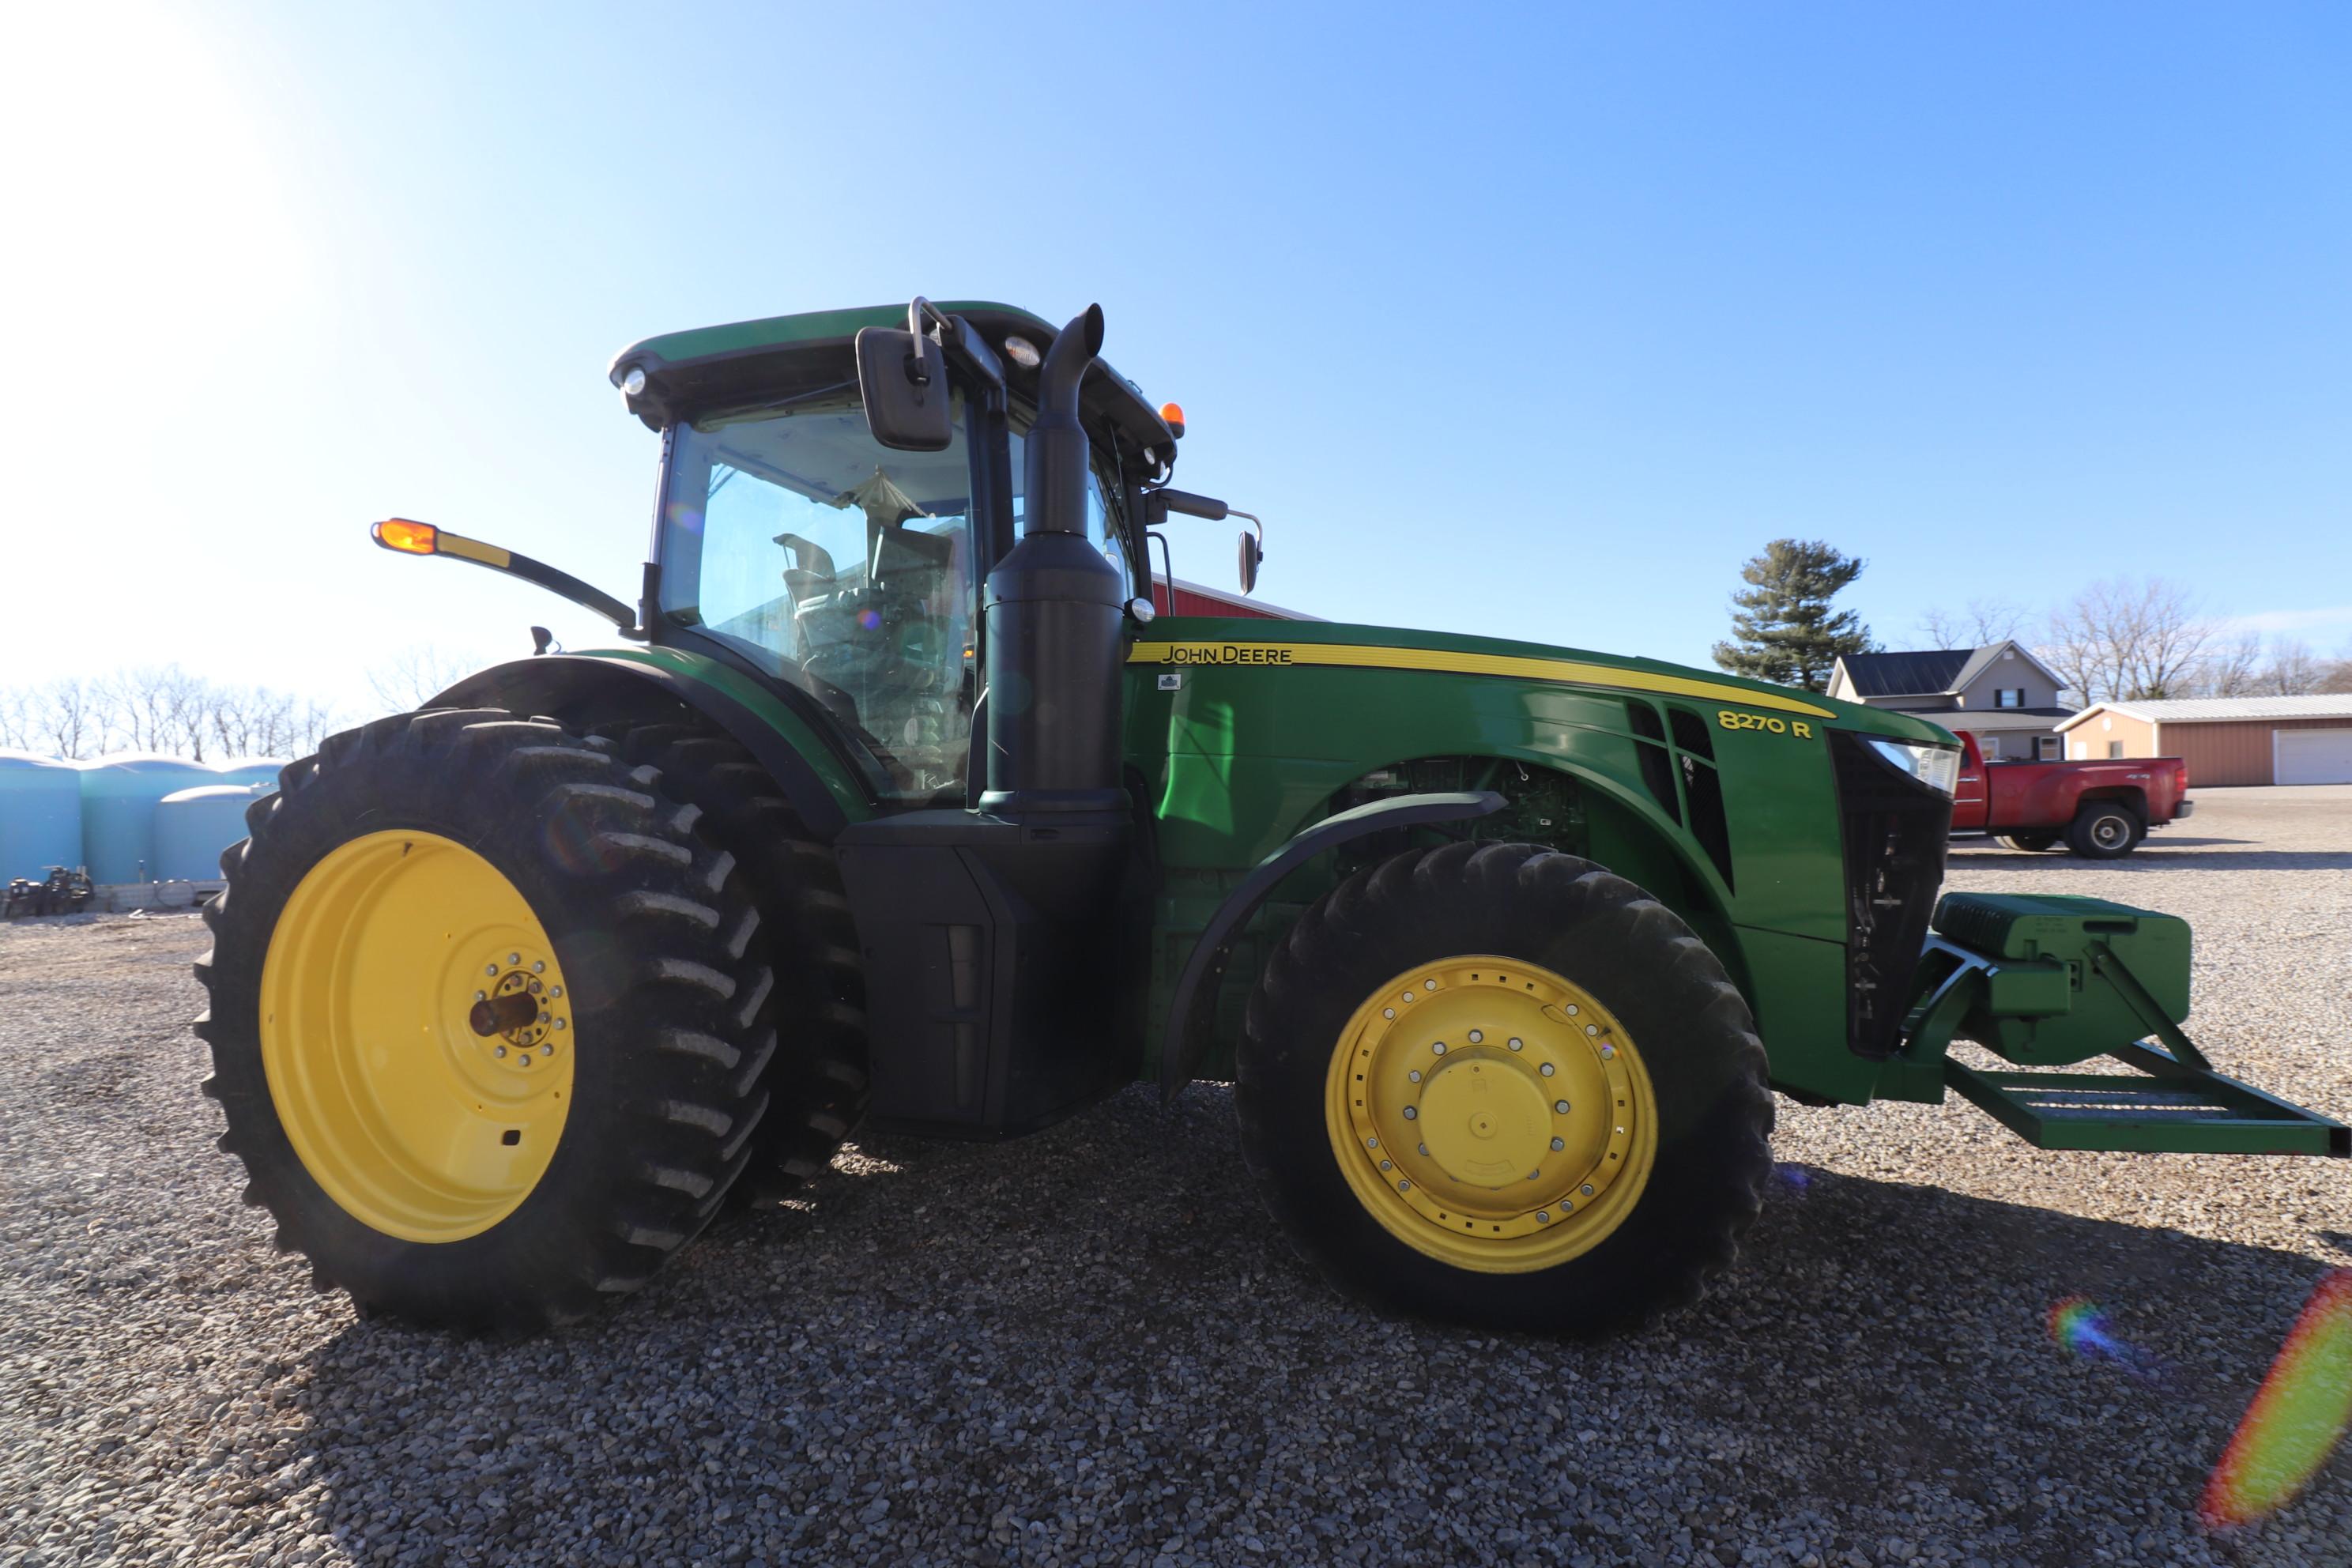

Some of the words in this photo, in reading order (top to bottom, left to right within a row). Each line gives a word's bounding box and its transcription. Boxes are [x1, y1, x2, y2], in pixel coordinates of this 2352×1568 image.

[1163, 646, 1217, 662] JOHN
[1223, 646, 1292, 662] DEERE
[1718, 710, 1785, 733] 8270
[1792, 721, 1812, 738] R
